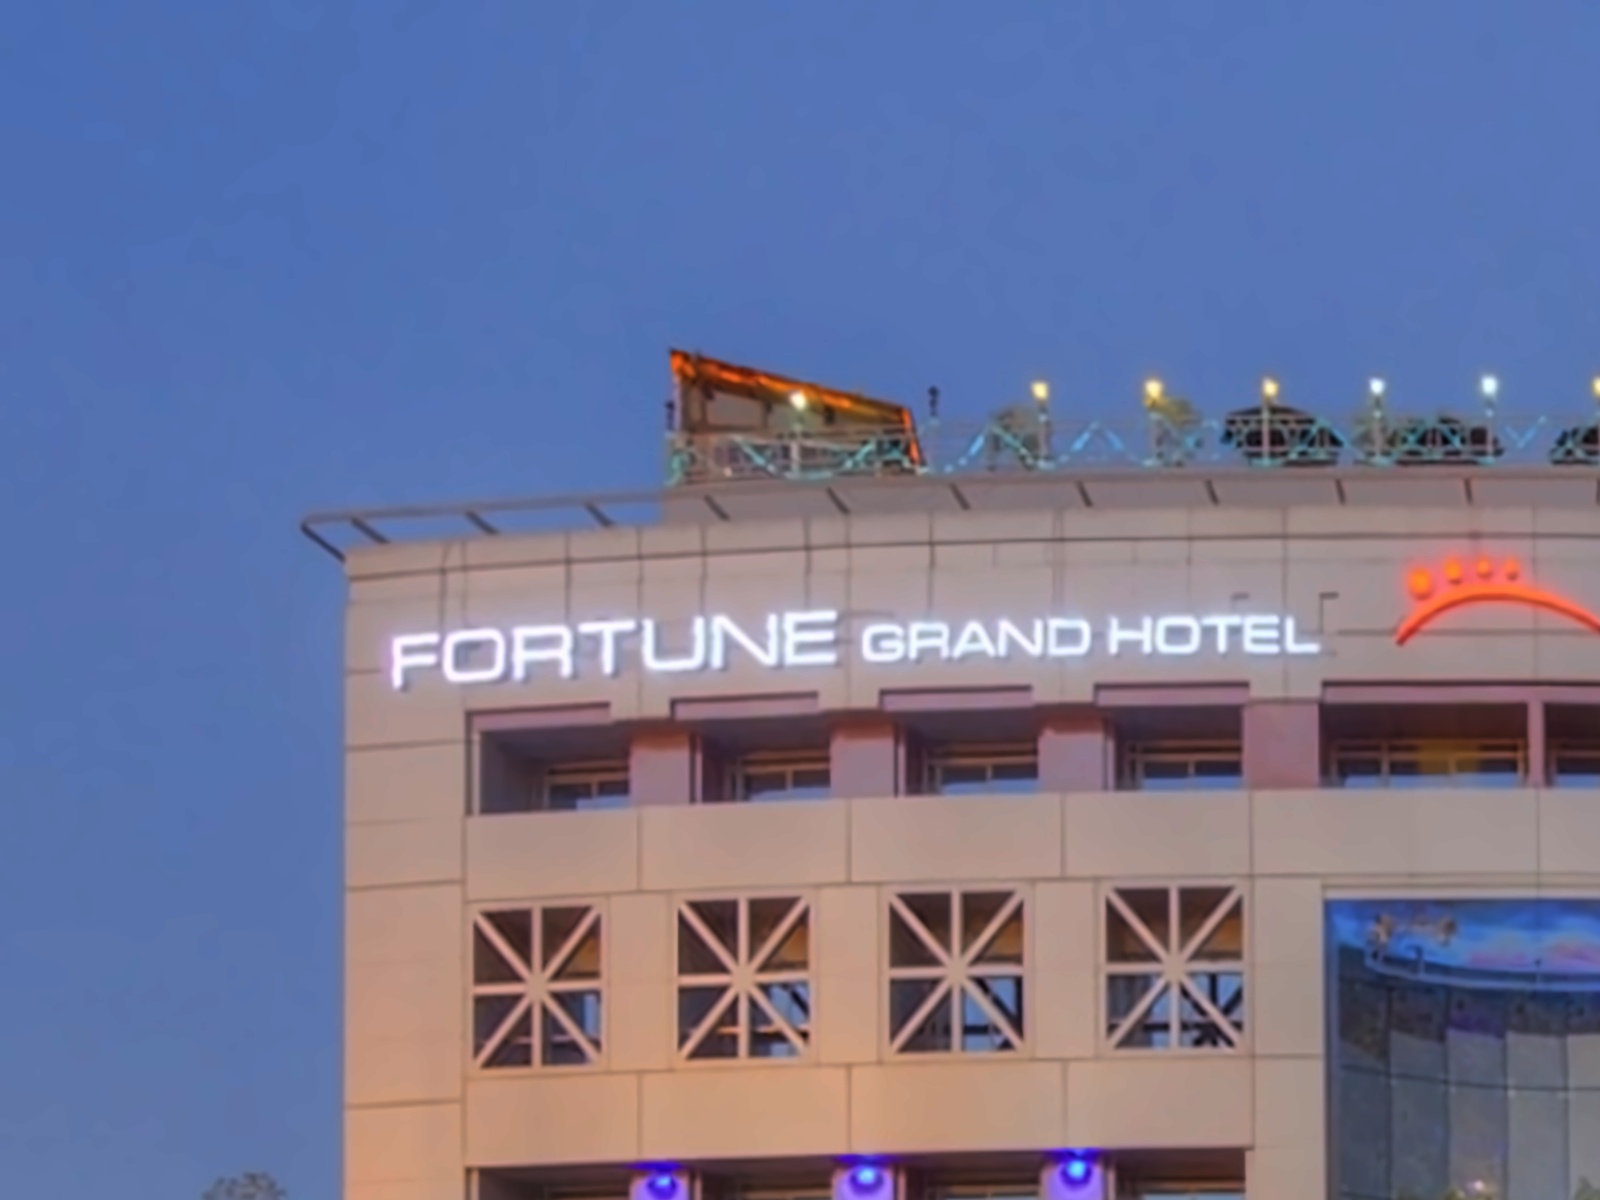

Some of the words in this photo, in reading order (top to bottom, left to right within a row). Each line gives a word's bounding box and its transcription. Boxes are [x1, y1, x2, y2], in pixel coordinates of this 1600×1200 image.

[389, 608, 839, 690] FORTUNE
[859, 617, 1093, 664] GRAND
[1106, 612, 1321, 657] HOTEL
